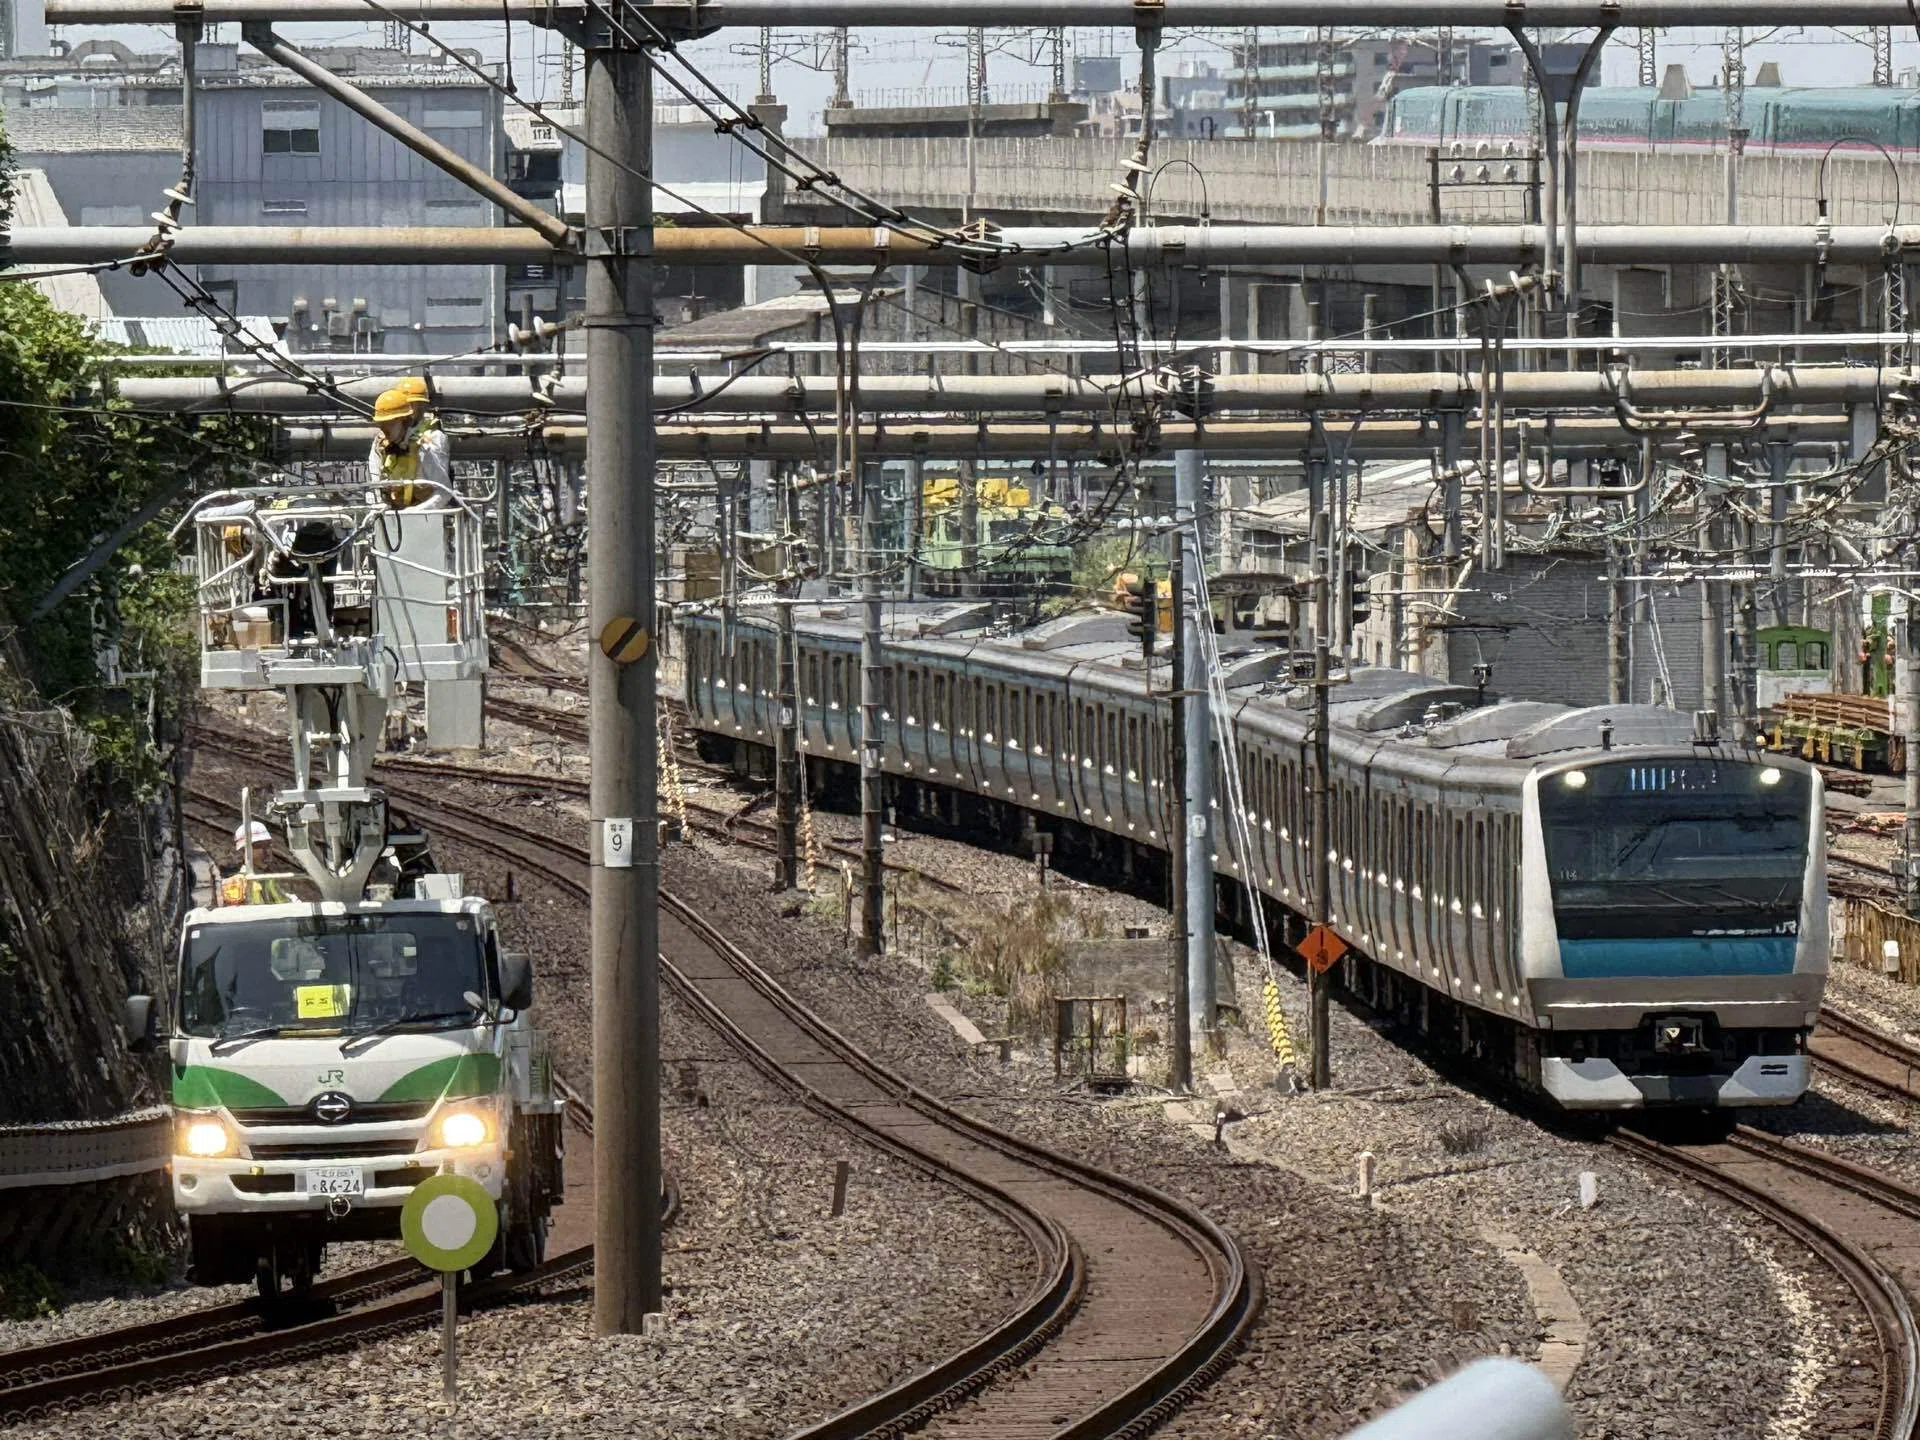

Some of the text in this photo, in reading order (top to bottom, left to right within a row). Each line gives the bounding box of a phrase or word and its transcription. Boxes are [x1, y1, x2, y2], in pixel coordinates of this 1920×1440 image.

[612, 833, 622, 852] 9
[1775, 919, 1797, 934] JR
[318, 1069, 344, 1084] JR
